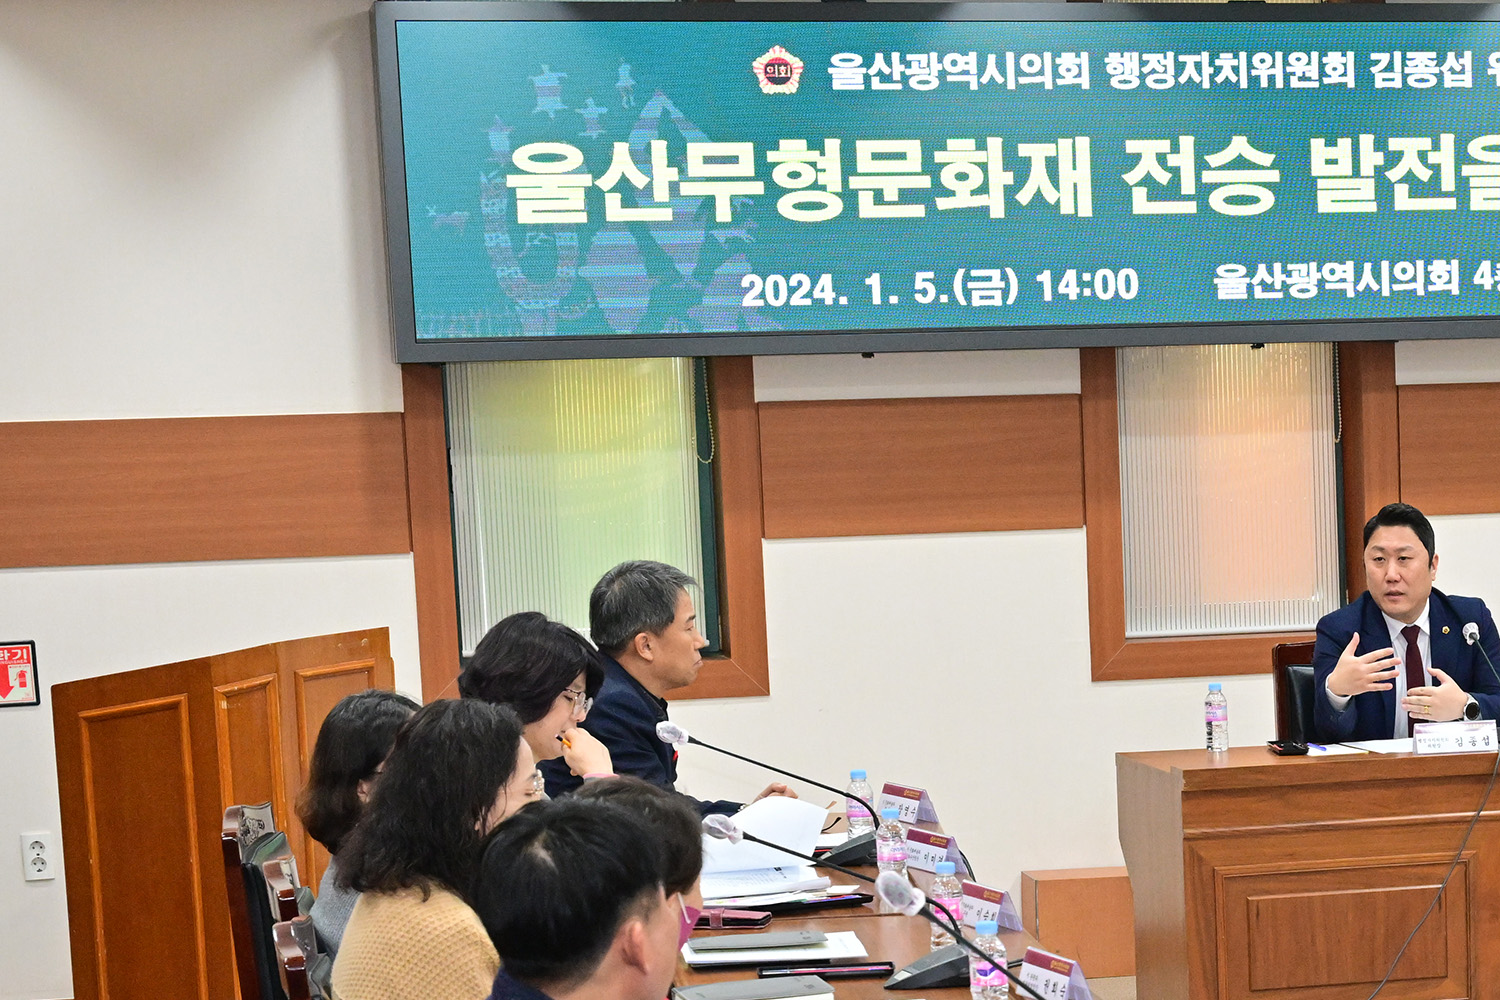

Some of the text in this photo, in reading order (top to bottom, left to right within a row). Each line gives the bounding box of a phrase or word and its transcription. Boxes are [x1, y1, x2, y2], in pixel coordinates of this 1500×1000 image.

[766, 64, 790, 77] 의회
[828, 52, 1091, 92] 울산광역시의회
[1105, 52, 1356, 91] 행정자치위원회
[1371, 51, 1474, 90] 김종섭
[507, 137, 1094, 225] 울산무형문화재
[1122, 136, 1281, 217] 전승
[741, 274, 849, 308] 2024.
[866, 273, 900, 306] 1.
[1037, 269, 1140, 303] 14:00
[1214, 260, 1461, 301] 울산광역시의회
[1455, 735, 1490, 748] 김종섭
